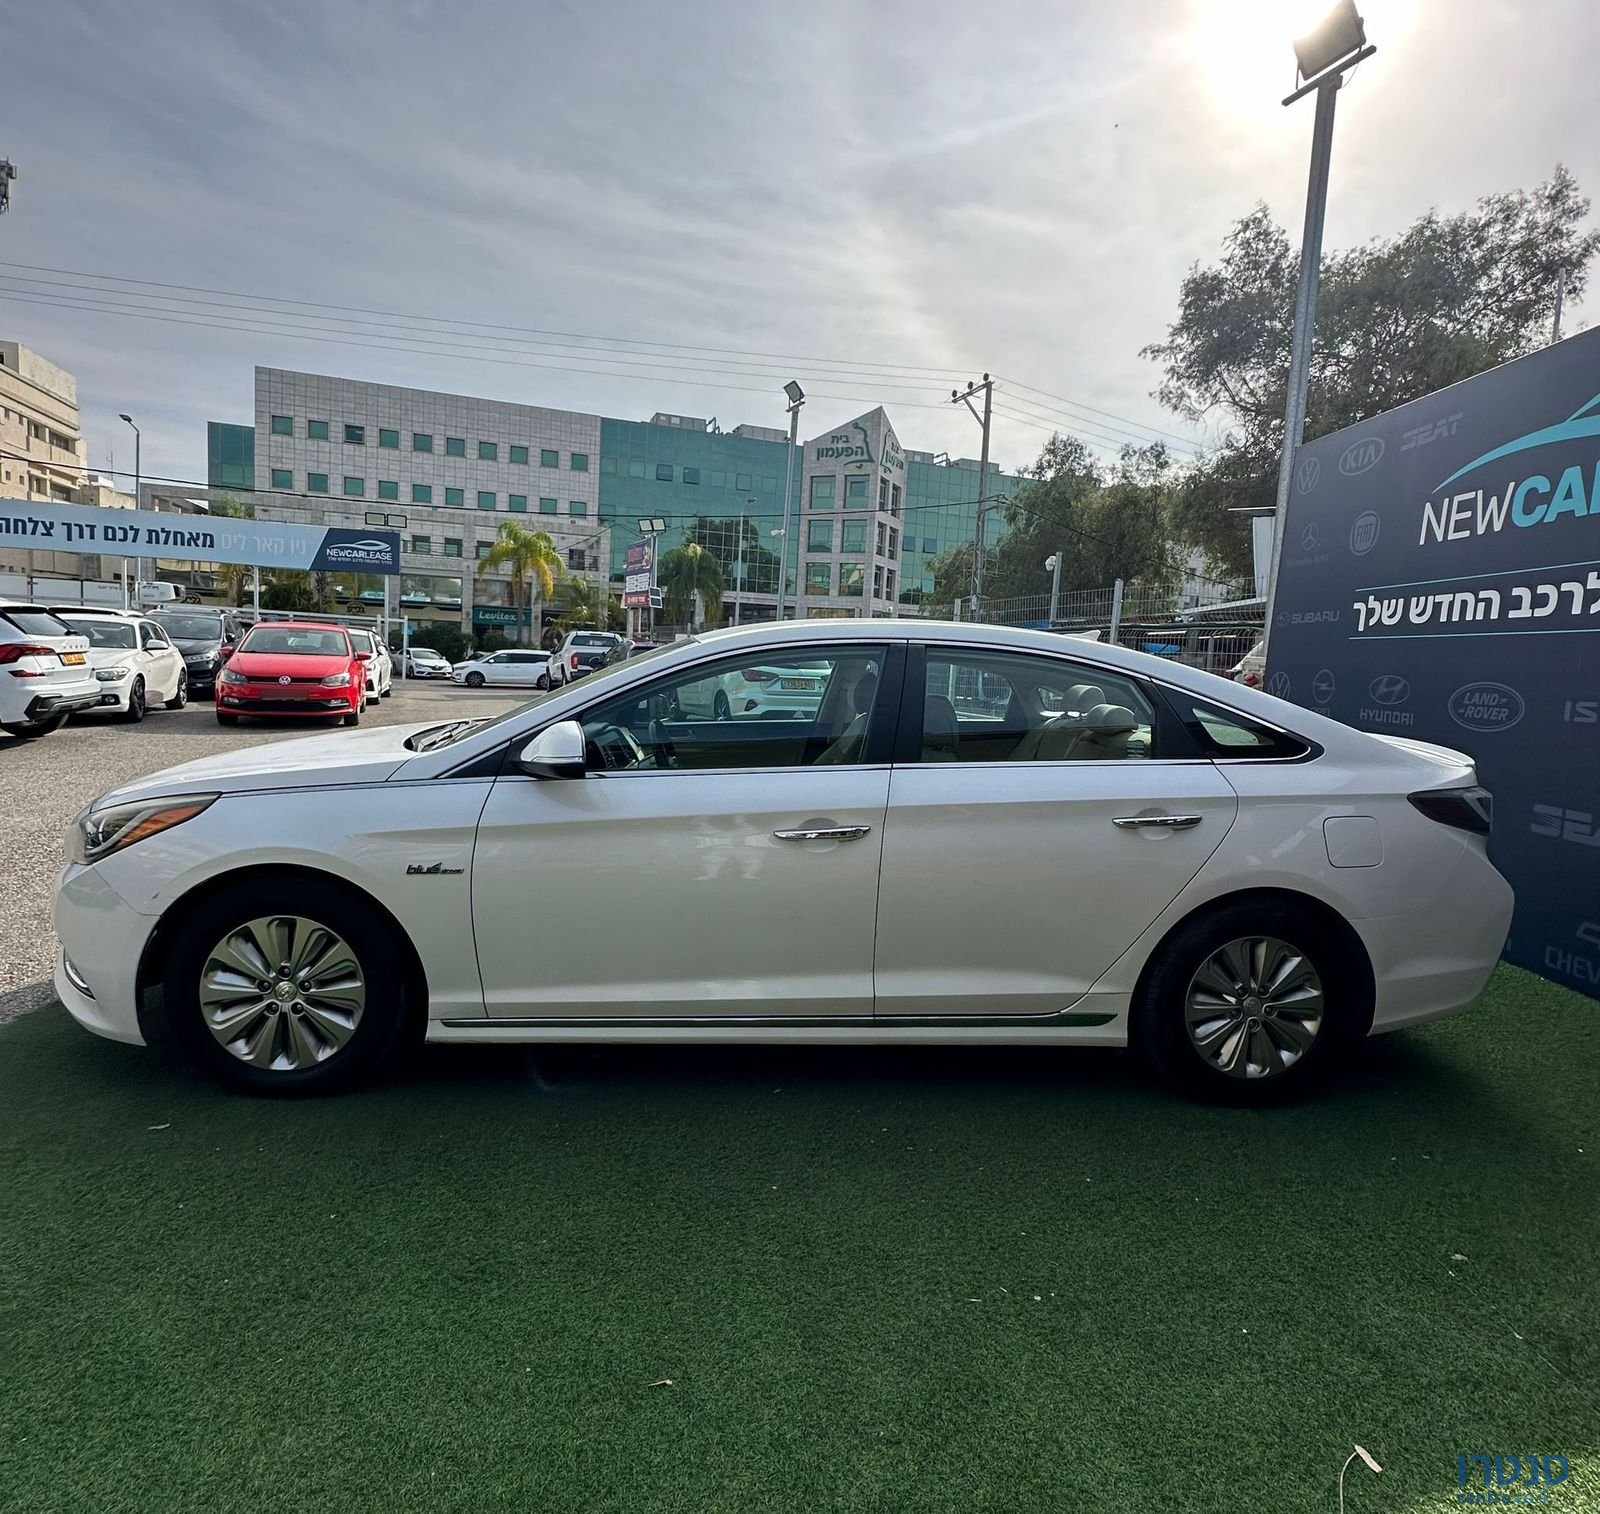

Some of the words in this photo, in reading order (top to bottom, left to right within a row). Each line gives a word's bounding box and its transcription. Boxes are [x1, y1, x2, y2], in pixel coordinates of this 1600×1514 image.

[831, 434, 850, 444] בית
[816, 446, 865, 461] הפעמון
[1346, 447, 1377, 470] KIA
[0, 516, 54, 537] צלחה
[61, 522, 96, 541] דרך
[103, 525, 140, 543] לכם
[146, 527, 215, 548] מאחלת
[479, 610, 517, 621] Levitex
[1353, 595, 1404, 632] שלך
[1409, 590, 1500, 624] החדש
[1291, 610, 1340, 625] SUBARU
[1463, 692, 1499, 706] LAND
[1360, 708, 1414, 726] HYUNDAI
[1464, 705, 1509, 721] ROVER
